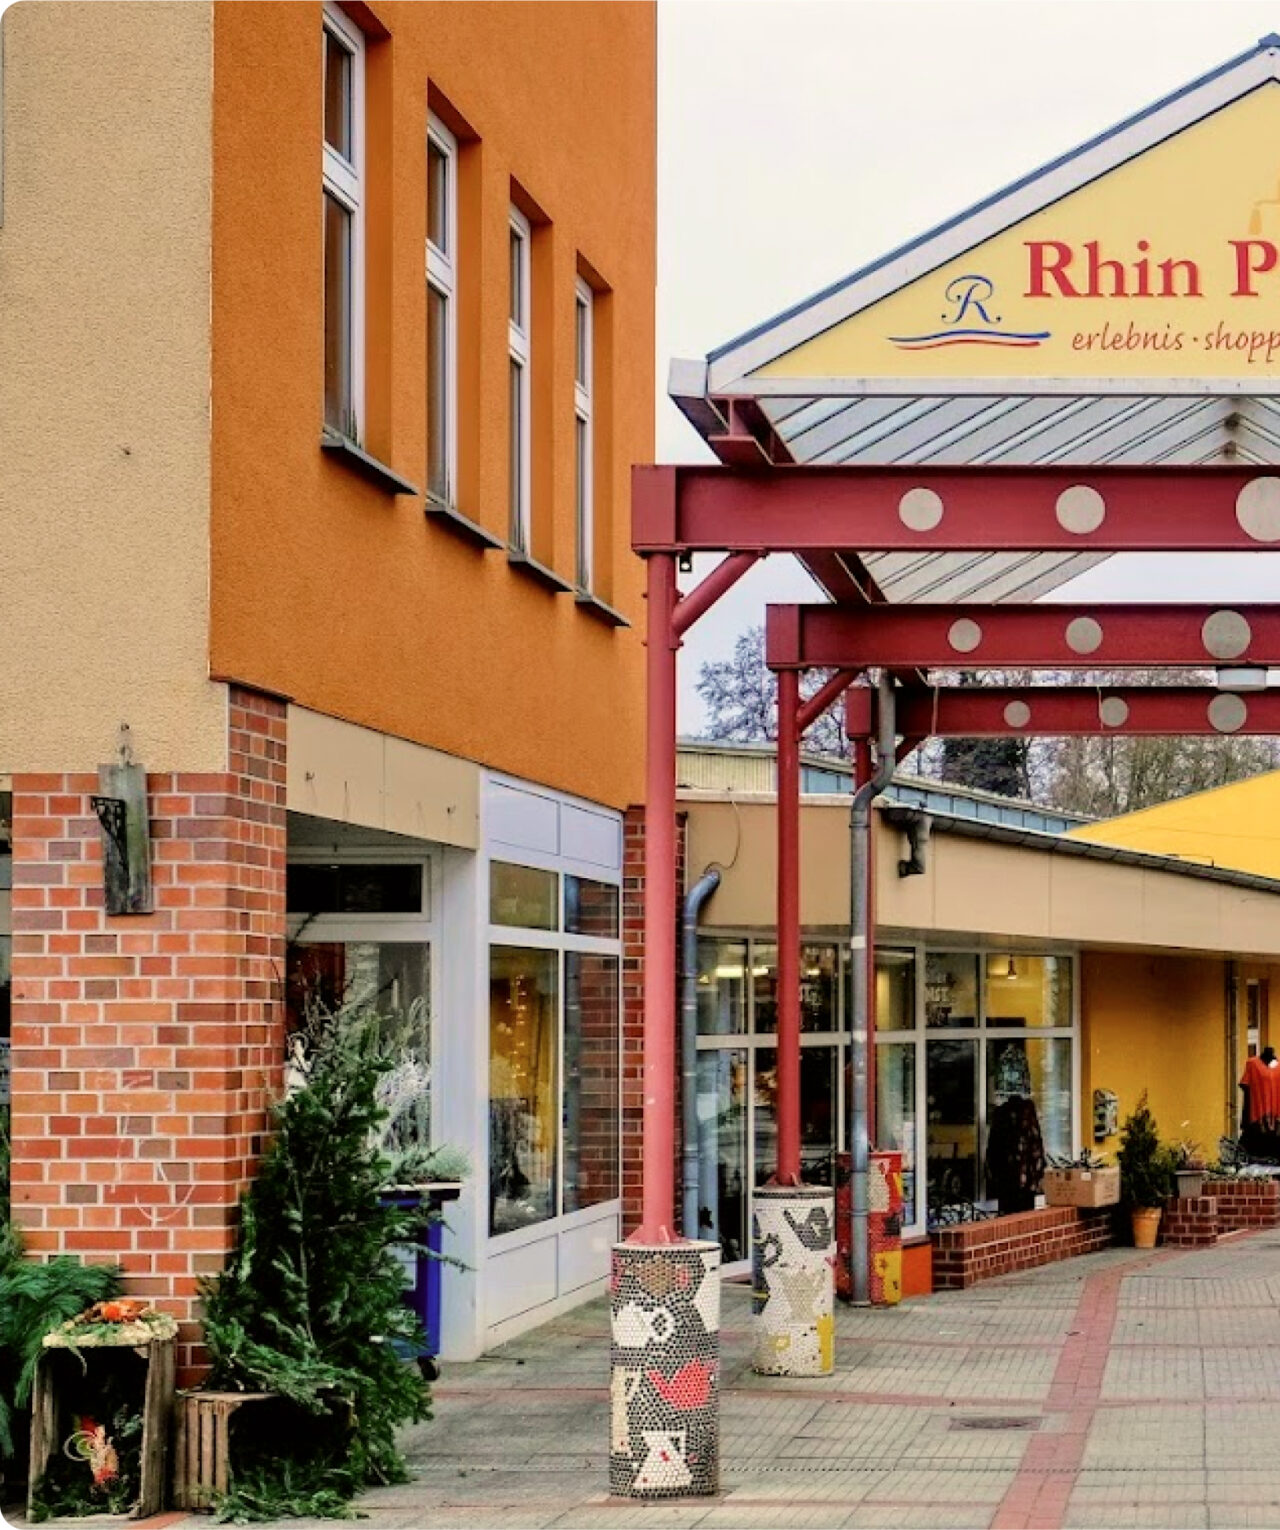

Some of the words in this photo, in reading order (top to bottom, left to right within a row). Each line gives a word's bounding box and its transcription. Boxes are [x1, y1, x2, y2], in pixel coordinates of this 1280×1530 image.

[1022, 240, 1204, 299] Rhin
[941, 274, 1002, 324] R
[1071, 320, 1184, 352] erlebnis
